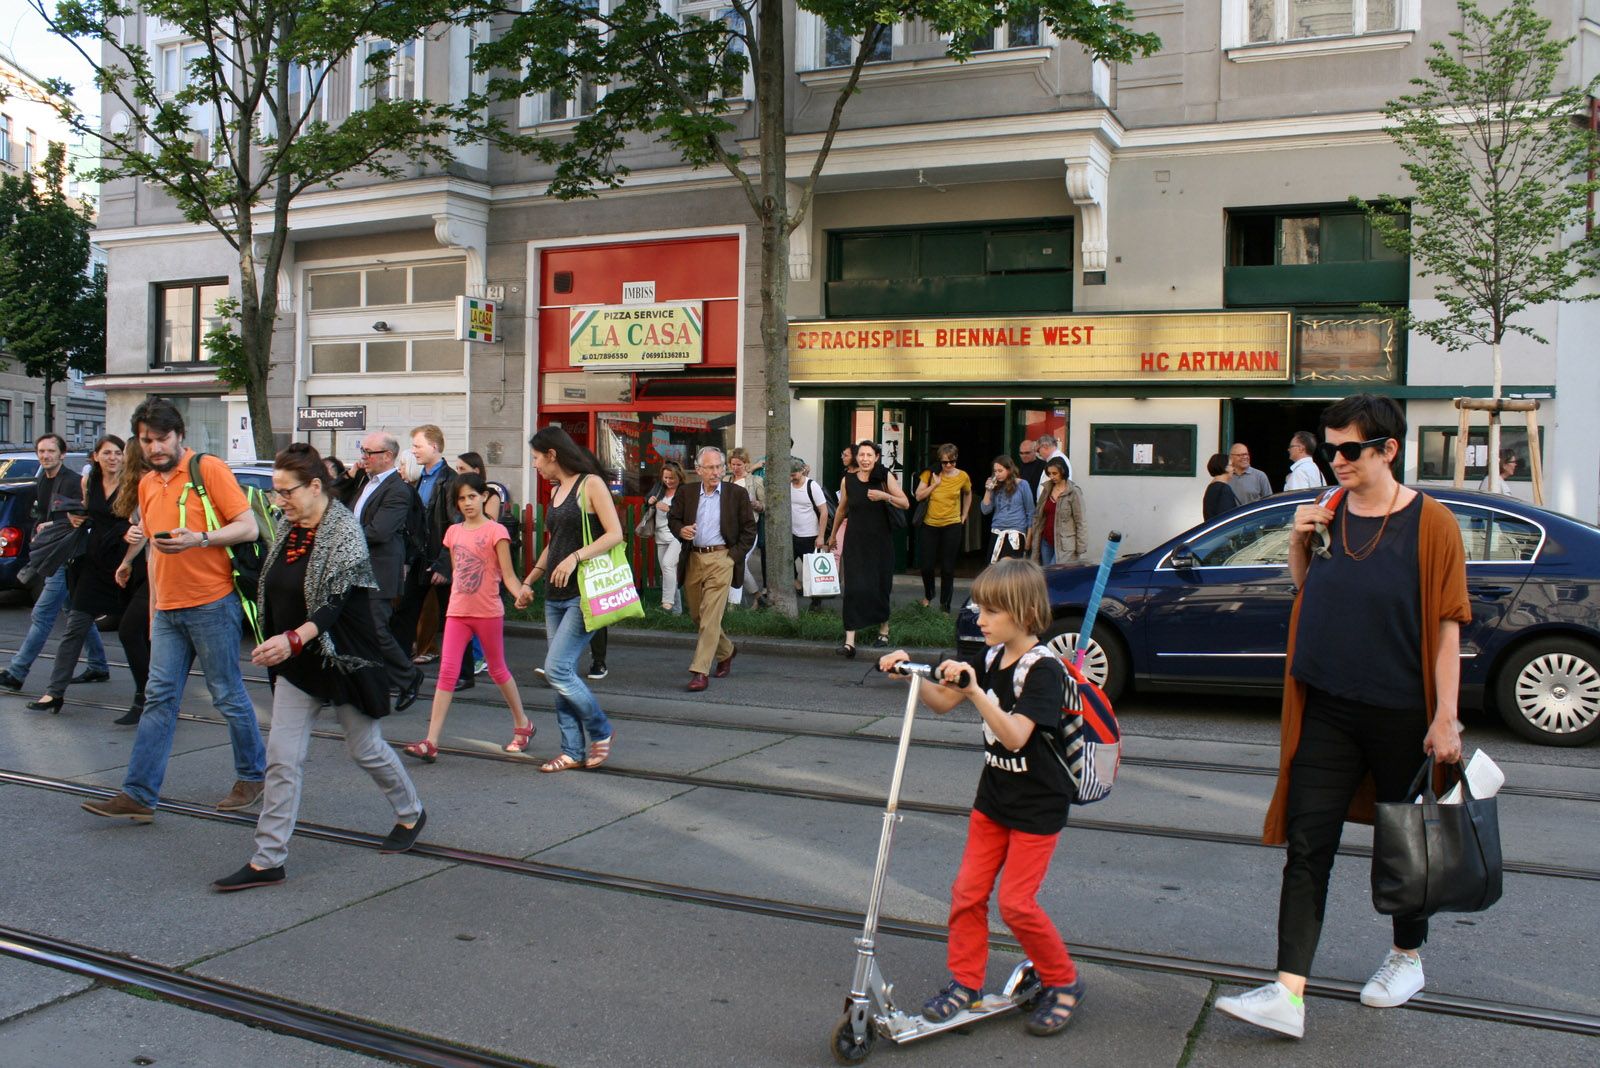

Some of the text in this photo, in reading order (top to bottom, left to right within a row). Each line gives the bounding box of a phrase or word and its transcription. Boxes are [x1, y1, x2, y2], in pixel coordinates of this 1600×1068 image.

[490, 287, 500, 297] 21
[624, 286, 654, 299] IMBISS
[604, 310, 674, 320] PIZZA SERVICE
[590, 322, 693, 347] LA CASA
[797, 326, 1094, 350] SPRACHSPIEL BIENNALE WEST
[589, 352, 629, 360] 01/7896550
[1141, 351, 1279, 372] HC ARTMANN
[316, 418, 345, 428] Straße
[587, 558, 609, 573] BIO
[592, 568, 632, 591] MACHT
[599, 586, 639, 611] SCHÖN
[985, 750, 1028, 772] PAULI
